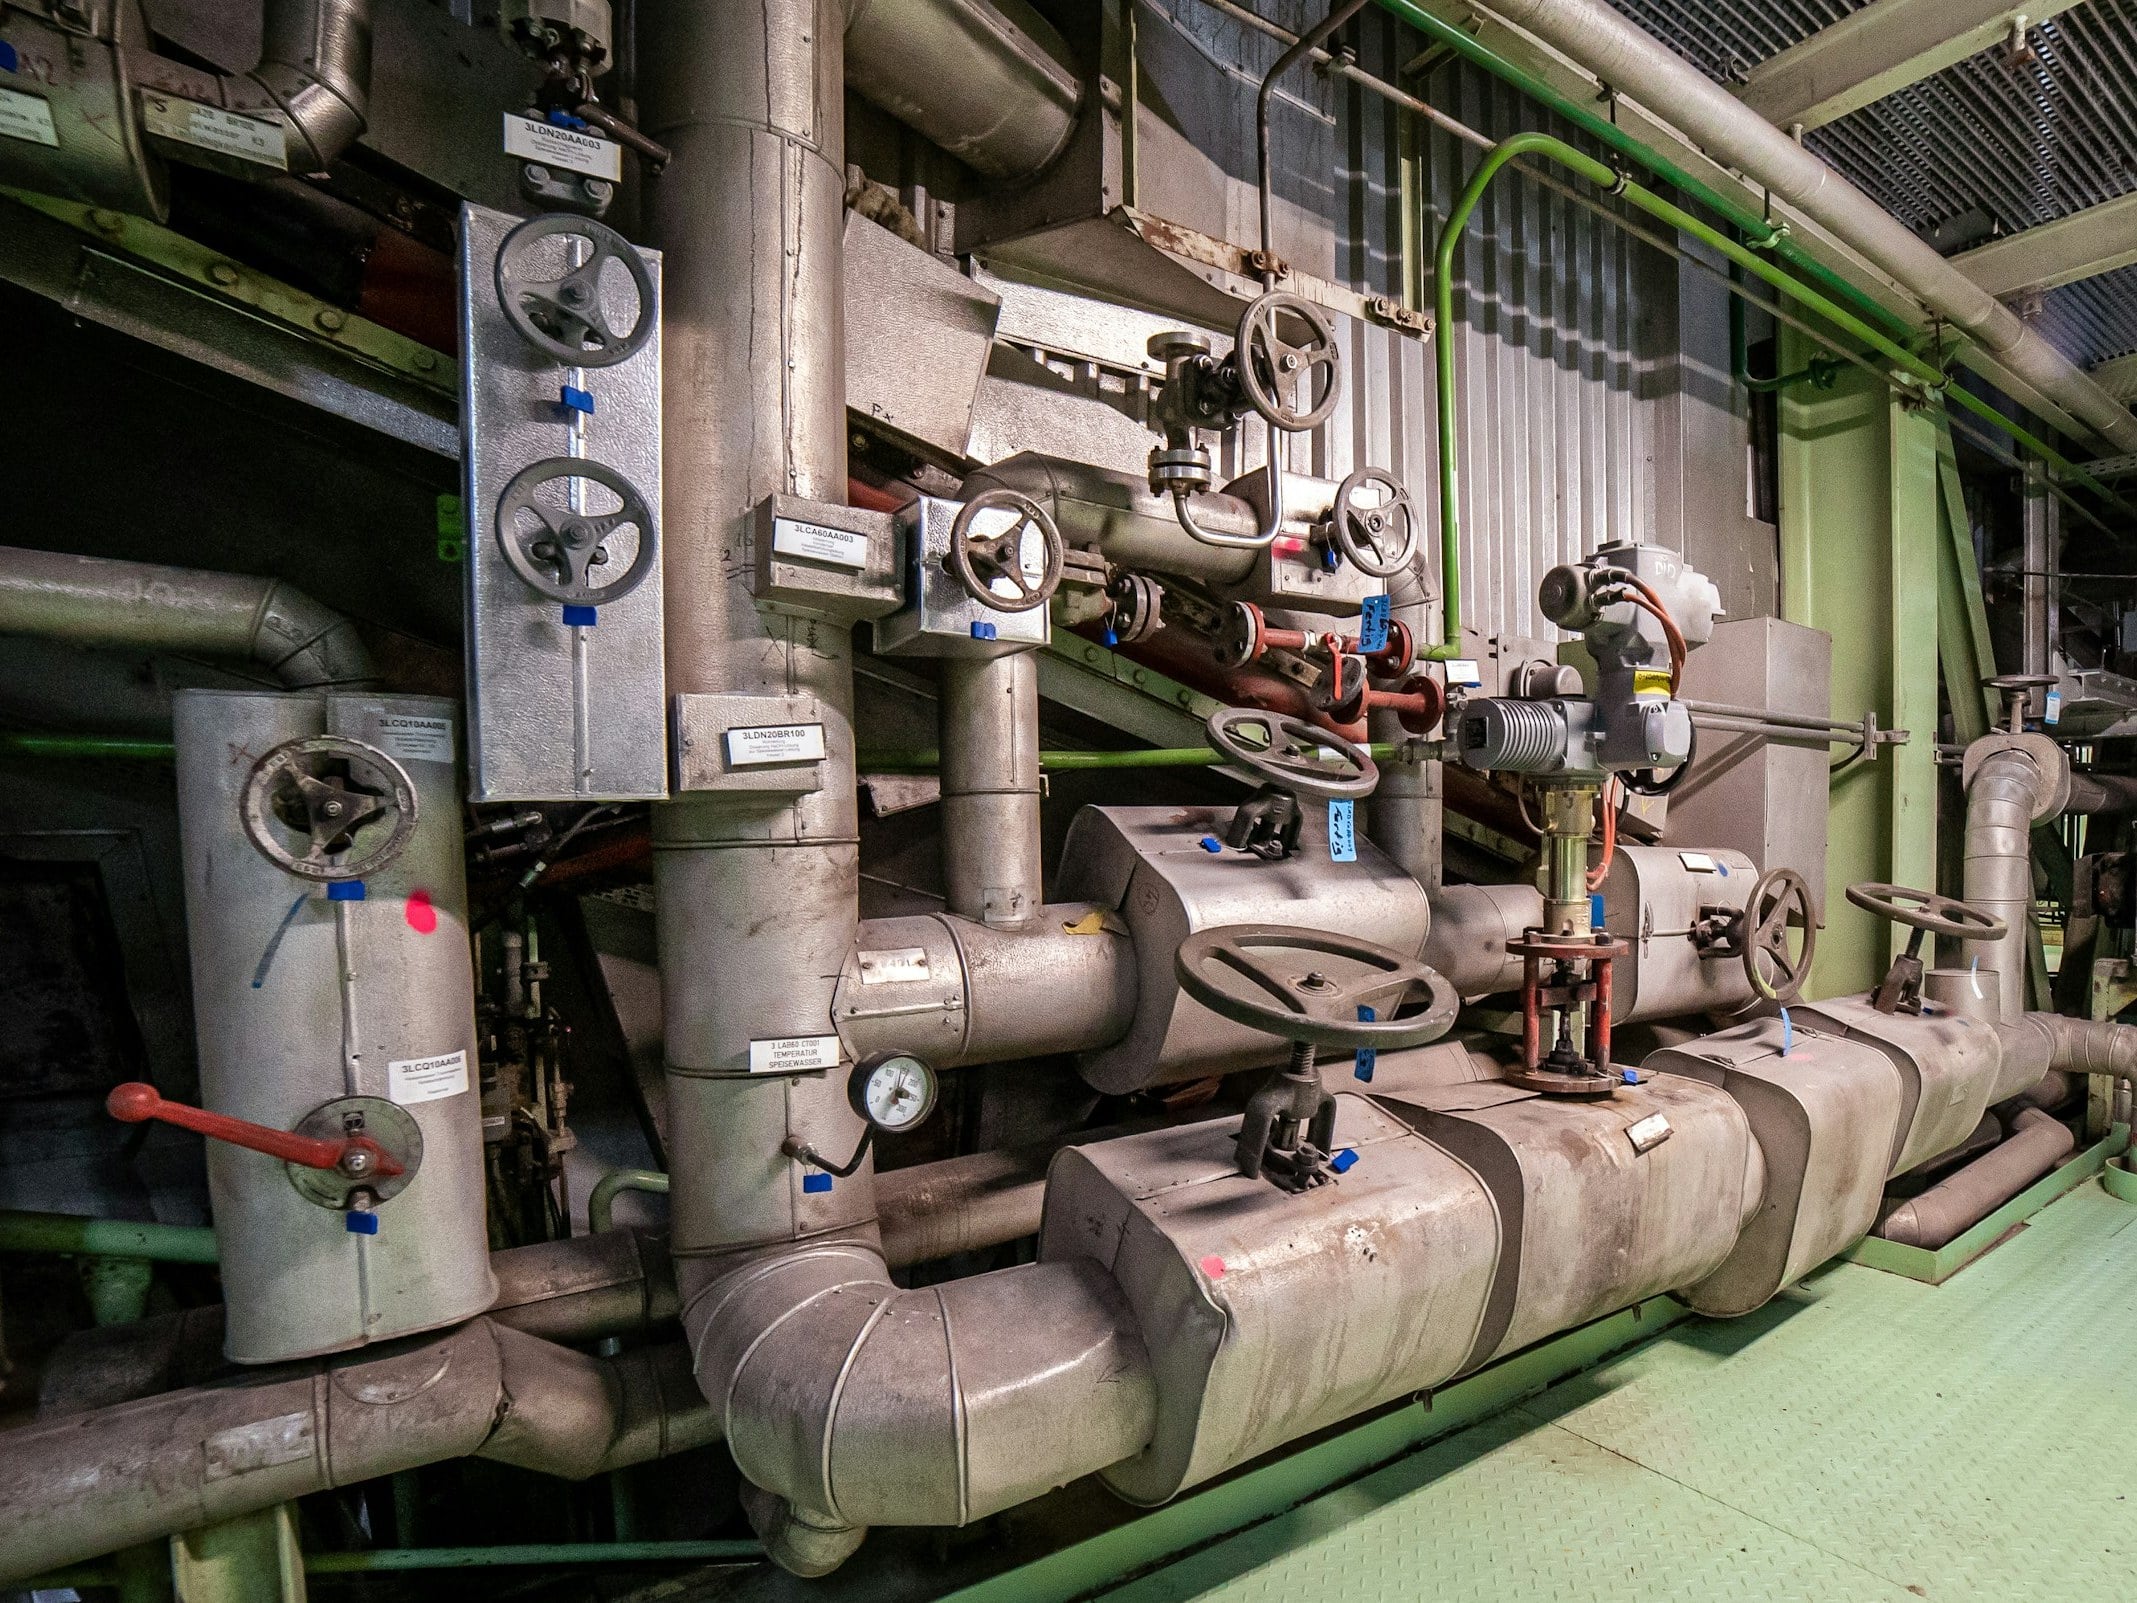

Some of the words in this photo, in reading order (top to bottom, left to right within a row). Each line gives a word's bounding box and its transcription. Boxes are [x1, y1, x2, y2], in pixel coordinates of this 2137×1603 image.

[524, 122, 601, 150] 3LDN20AA003
[794, 524, 854, 544] 3LCA60AA003
[720, 549, 732, 562] 2
[742, 729, 806, 740] 3LDN20BR100
[771, 1042, 776, 1050] 3
[801, 1039, 820, 1048] CT001
[773, 1048, 818, 1059] TEMPERATUR
[768, 1058, 822, 1069] SPEISEWASSER
